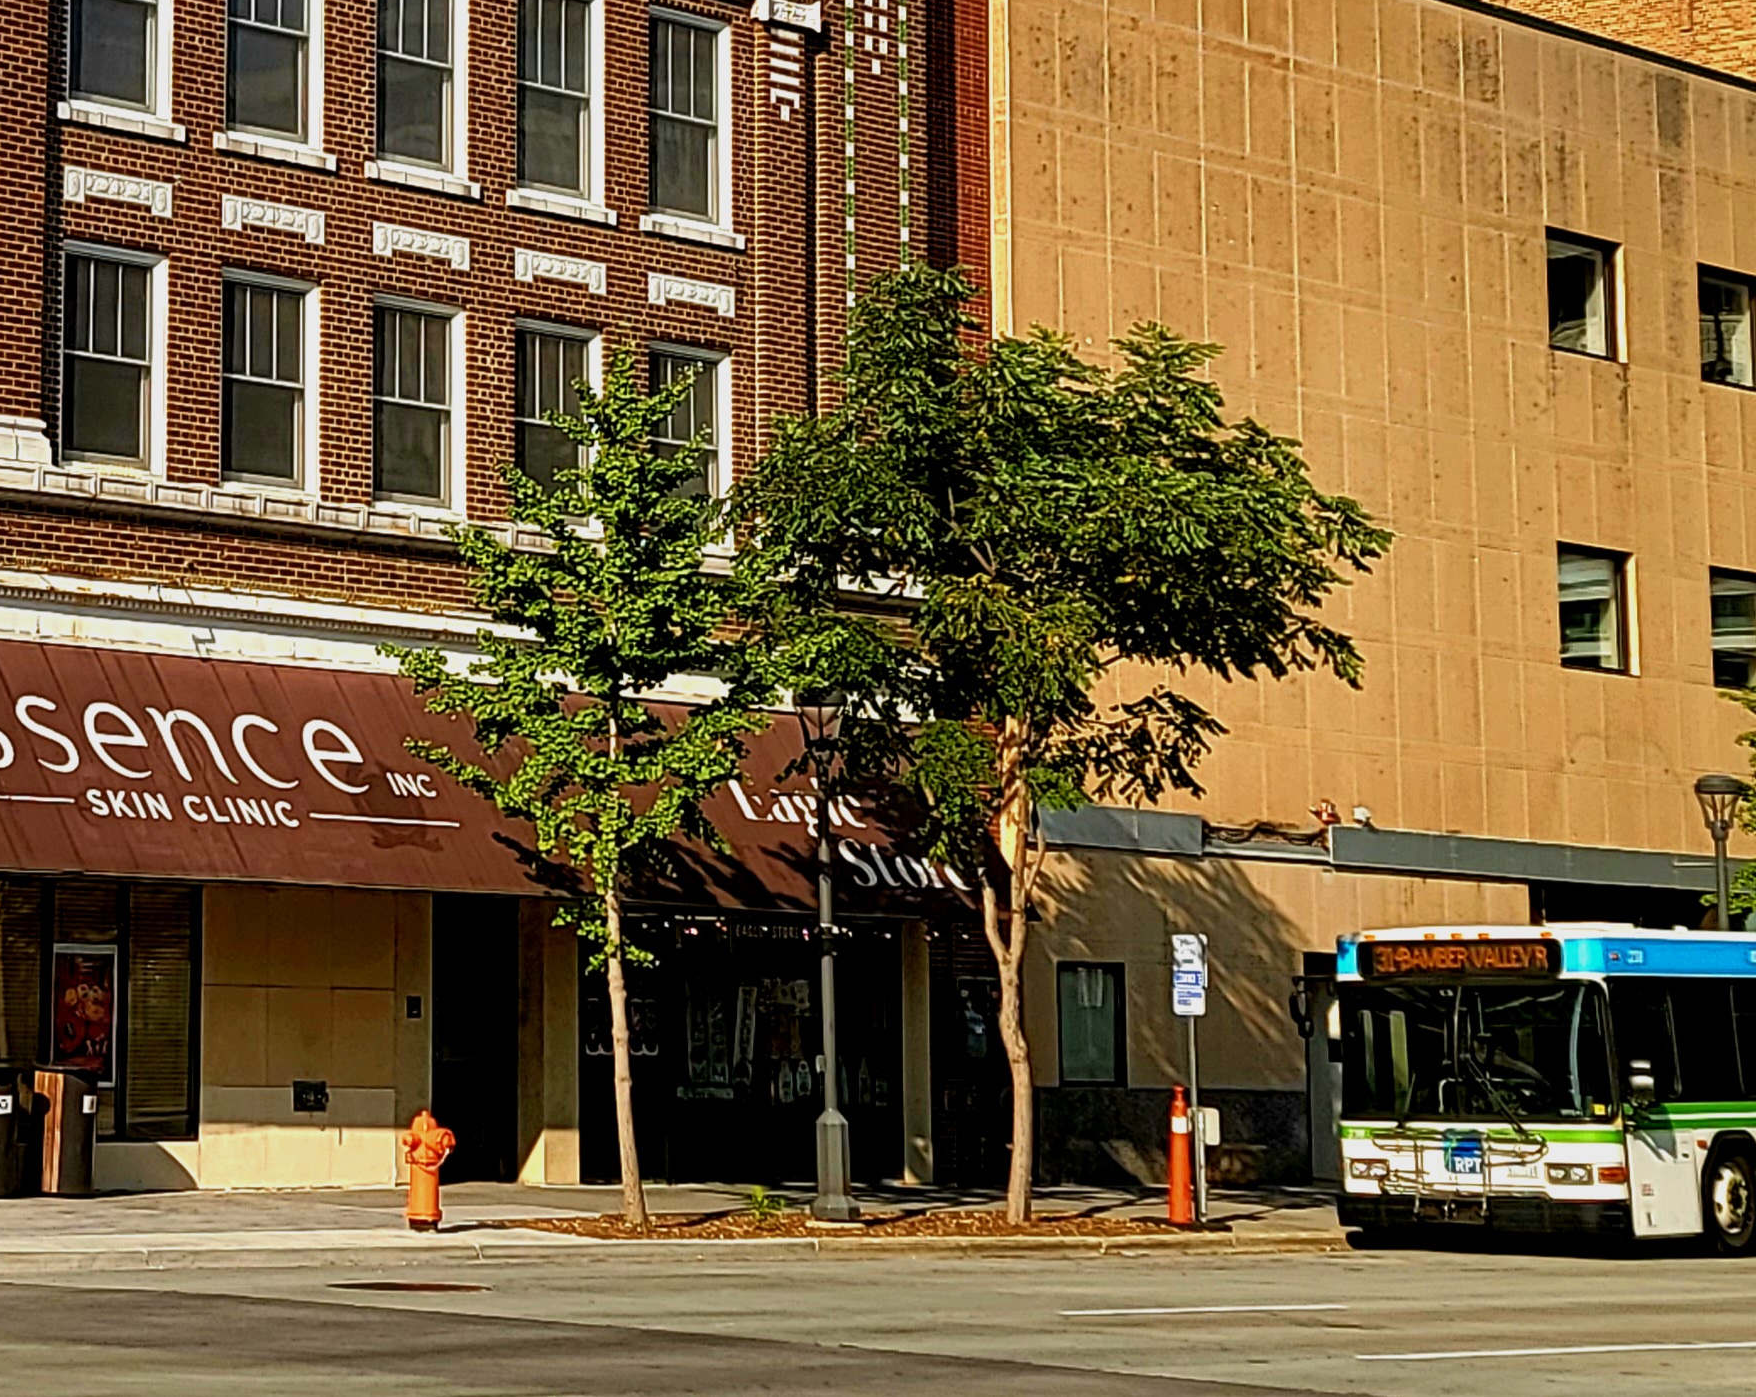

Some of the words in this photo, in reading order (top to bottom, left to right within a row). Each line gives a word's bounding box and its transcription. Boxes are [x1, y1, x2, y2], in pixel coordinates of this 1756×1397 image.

[386, 772, 438, 798] INC
[85, 789, 173, 821] SKIN
[183, 794, 301, 828] CLINIC
[1471, 945, 1532, 970] VALLEY
[1453, 1156, 1482, 1173] RPT
